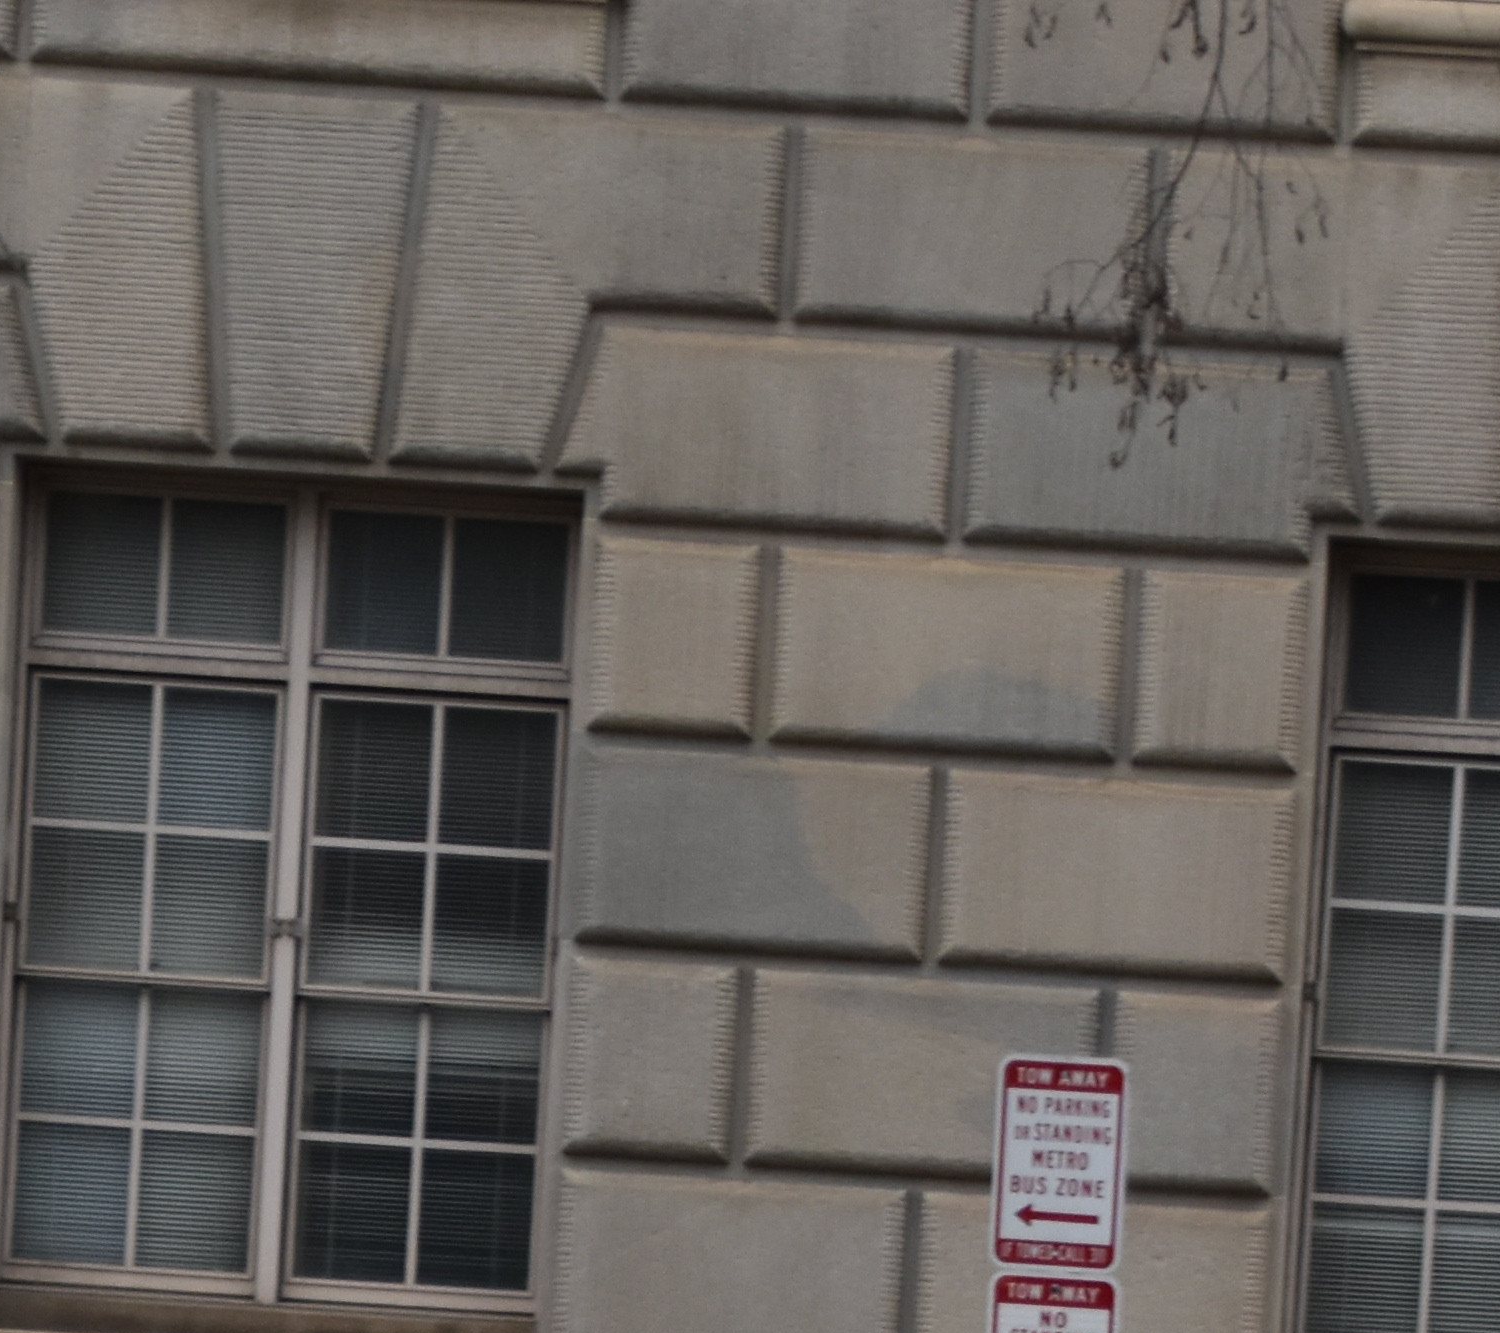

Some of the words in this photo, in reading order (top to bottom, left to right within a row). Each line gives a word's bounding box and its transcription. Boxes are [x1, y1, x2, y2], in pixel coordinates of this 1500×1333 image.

[1017, 1066, 1053, 1084] TOW
[1057, 1069, 1110, 1088] AWAY
[1016, 1096, 1037, 1114] NO
[1044, 1097, 1111, 1118] PARKING
[1033, 1123, 1112, 1145] STANDING
[1031, 1150, 1088, 1170] METRO
[1011, 1175, 1046, 1195] BUS
[1055, 1178, 1105, 1199] ZONE
[1007, 1282, 1043, 1299] TOW
[1040, 1312, 1067, 1328] NO
